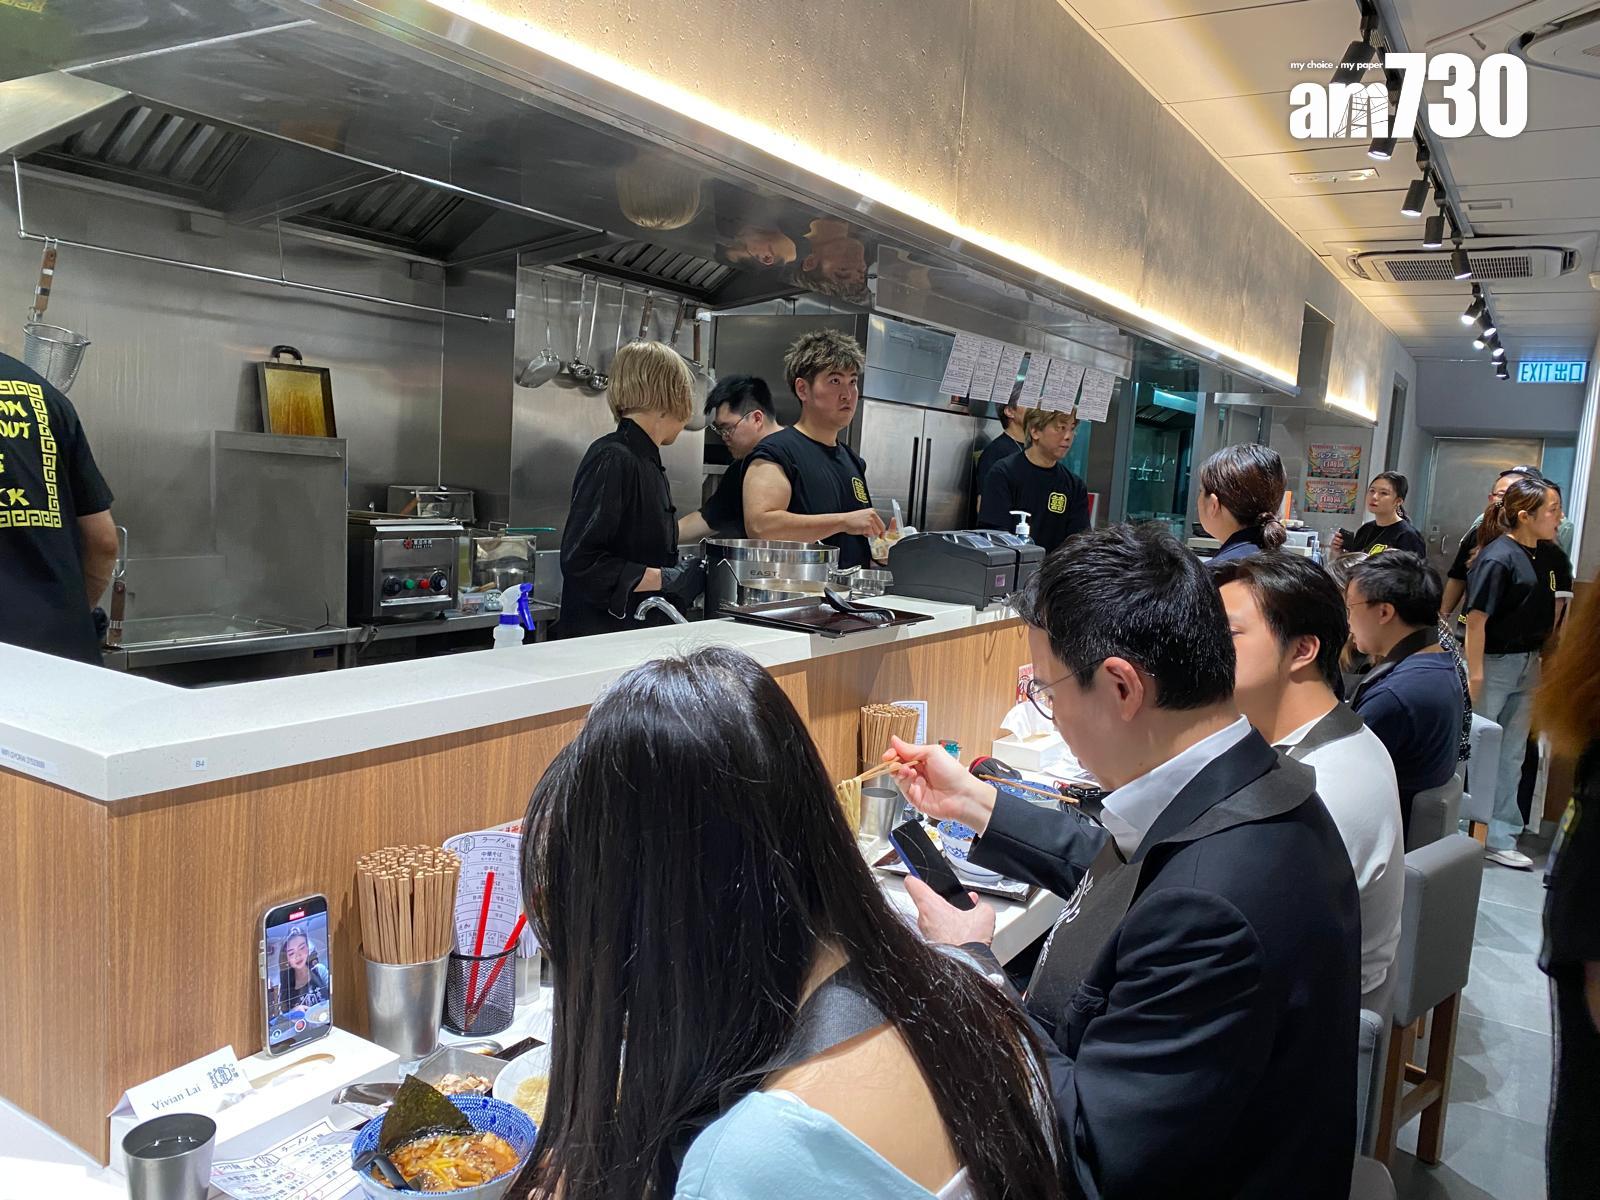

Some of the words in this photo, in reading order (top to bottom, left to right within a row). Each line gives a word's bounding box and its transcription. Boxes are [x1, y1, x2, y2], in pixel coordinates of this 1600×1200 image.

[1521, 363, 1552, 381] EXIT
[1555, 363, 1583, 381] 出口
[152, 1093, 185, 1111] Vivian
[185, 1084, 201, 1097] Lai
